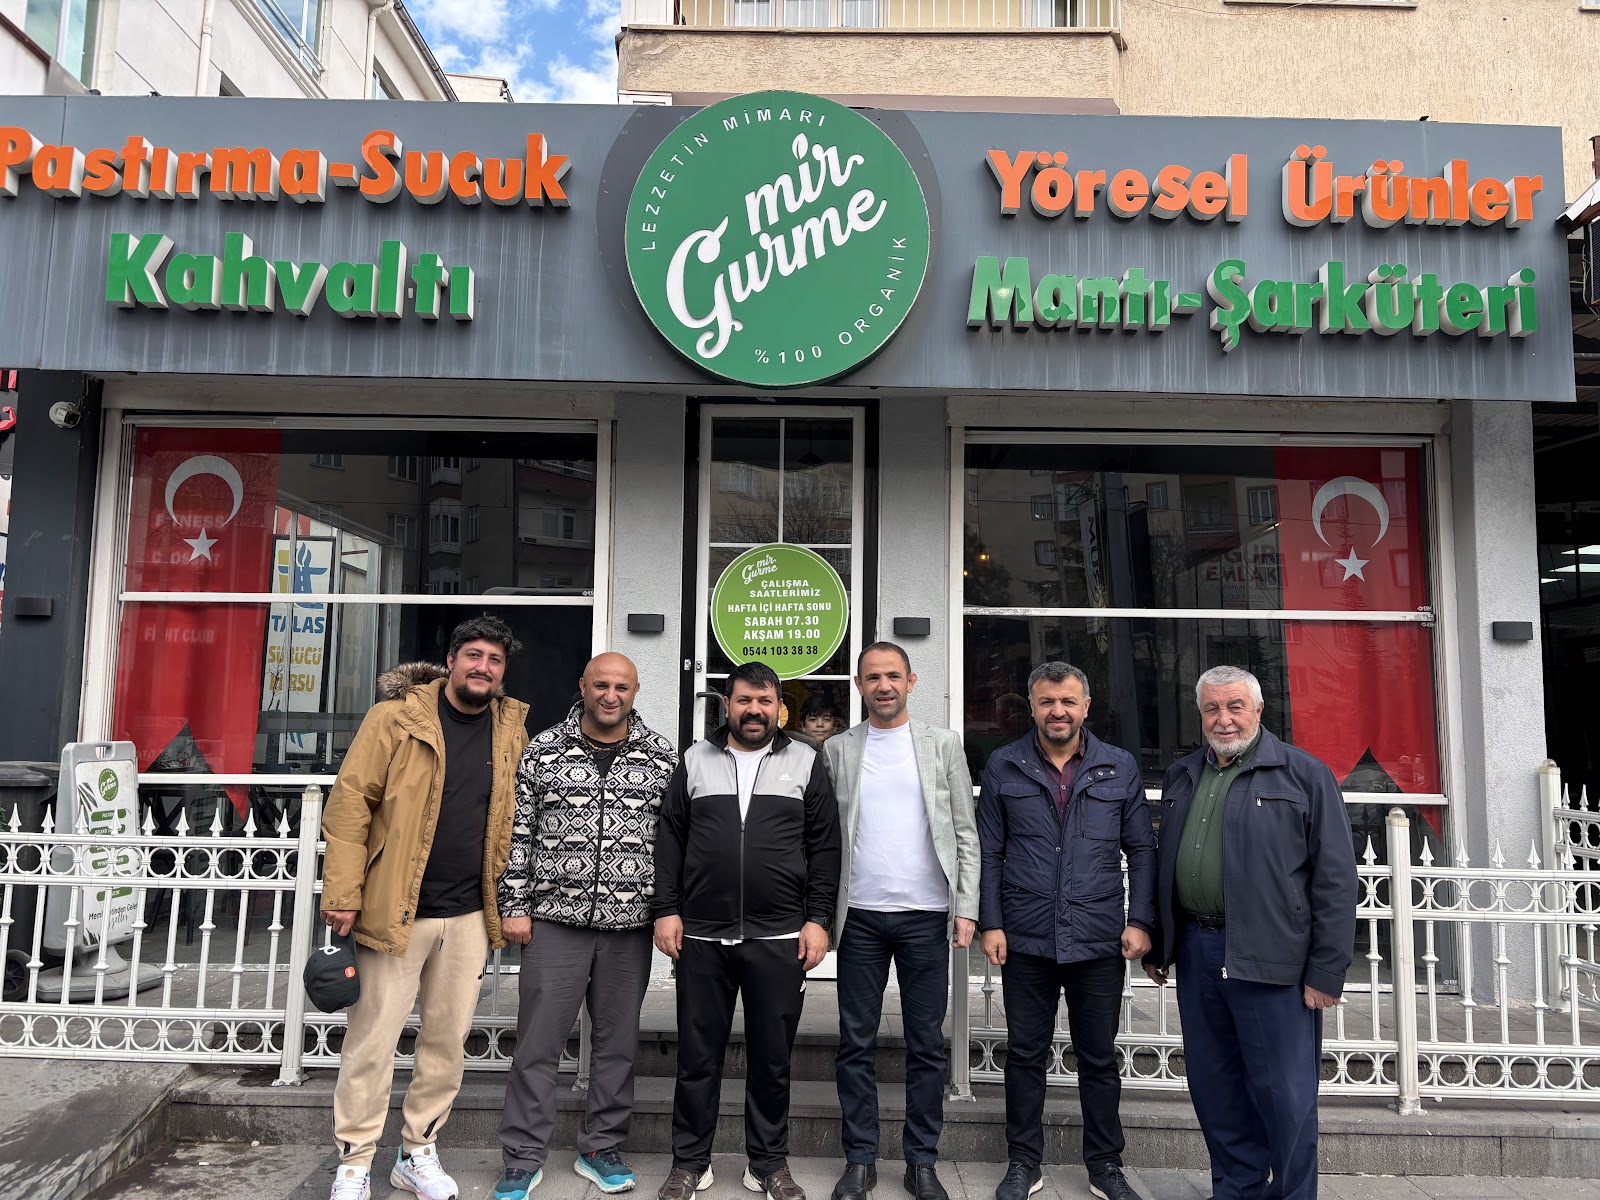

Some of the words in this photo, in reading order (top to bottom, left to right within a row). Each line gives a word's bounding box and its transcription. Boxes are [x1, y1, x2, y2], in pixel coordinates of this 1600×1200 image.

[642, 132, 708, 250] LEZZETİN
[723, 108, 825, 131] MİMARI
[745, 132, 864, 235] mir
[986, 149, 1248, 222] Yöresel
[1282, 144, 1543, 228] Ürünler
[106, 232, 474, 320] Kahvaltı
[666, 189, 887, 359] Gurme
[754, 345, 822, 364] %100
[838, 236, 906, 345] ORGANİK
[155, 512, 225, 528] FTNESS
[757, 554, 777, 568] mir
[742, 564, 777, 584] Gurme
[761, 579, 809, 589] ÇALIŞMA
[750, 588, 820, 598] SAATLERİMİZ
[728, 604, 757, 612] HAFTA
[760, 602, 772, 614] İÇİ
[775, 603, 804, 612] HAFTA
[807, 602, 831, 611] SONU
[744, 616, 783, 627] SABAH
[786, 616, 819, 625] 07.30
[144, 624, 179, 641] FIHT
[744, 630, 783, 642] AKŞAM
[787, 629, 820, 639] 19.00
[743, 646, 767, 656] 0544
[771, 646, 788, 655] 103
[791, 646, 803, 655] 38
[806, 645, 818, 655] 38
